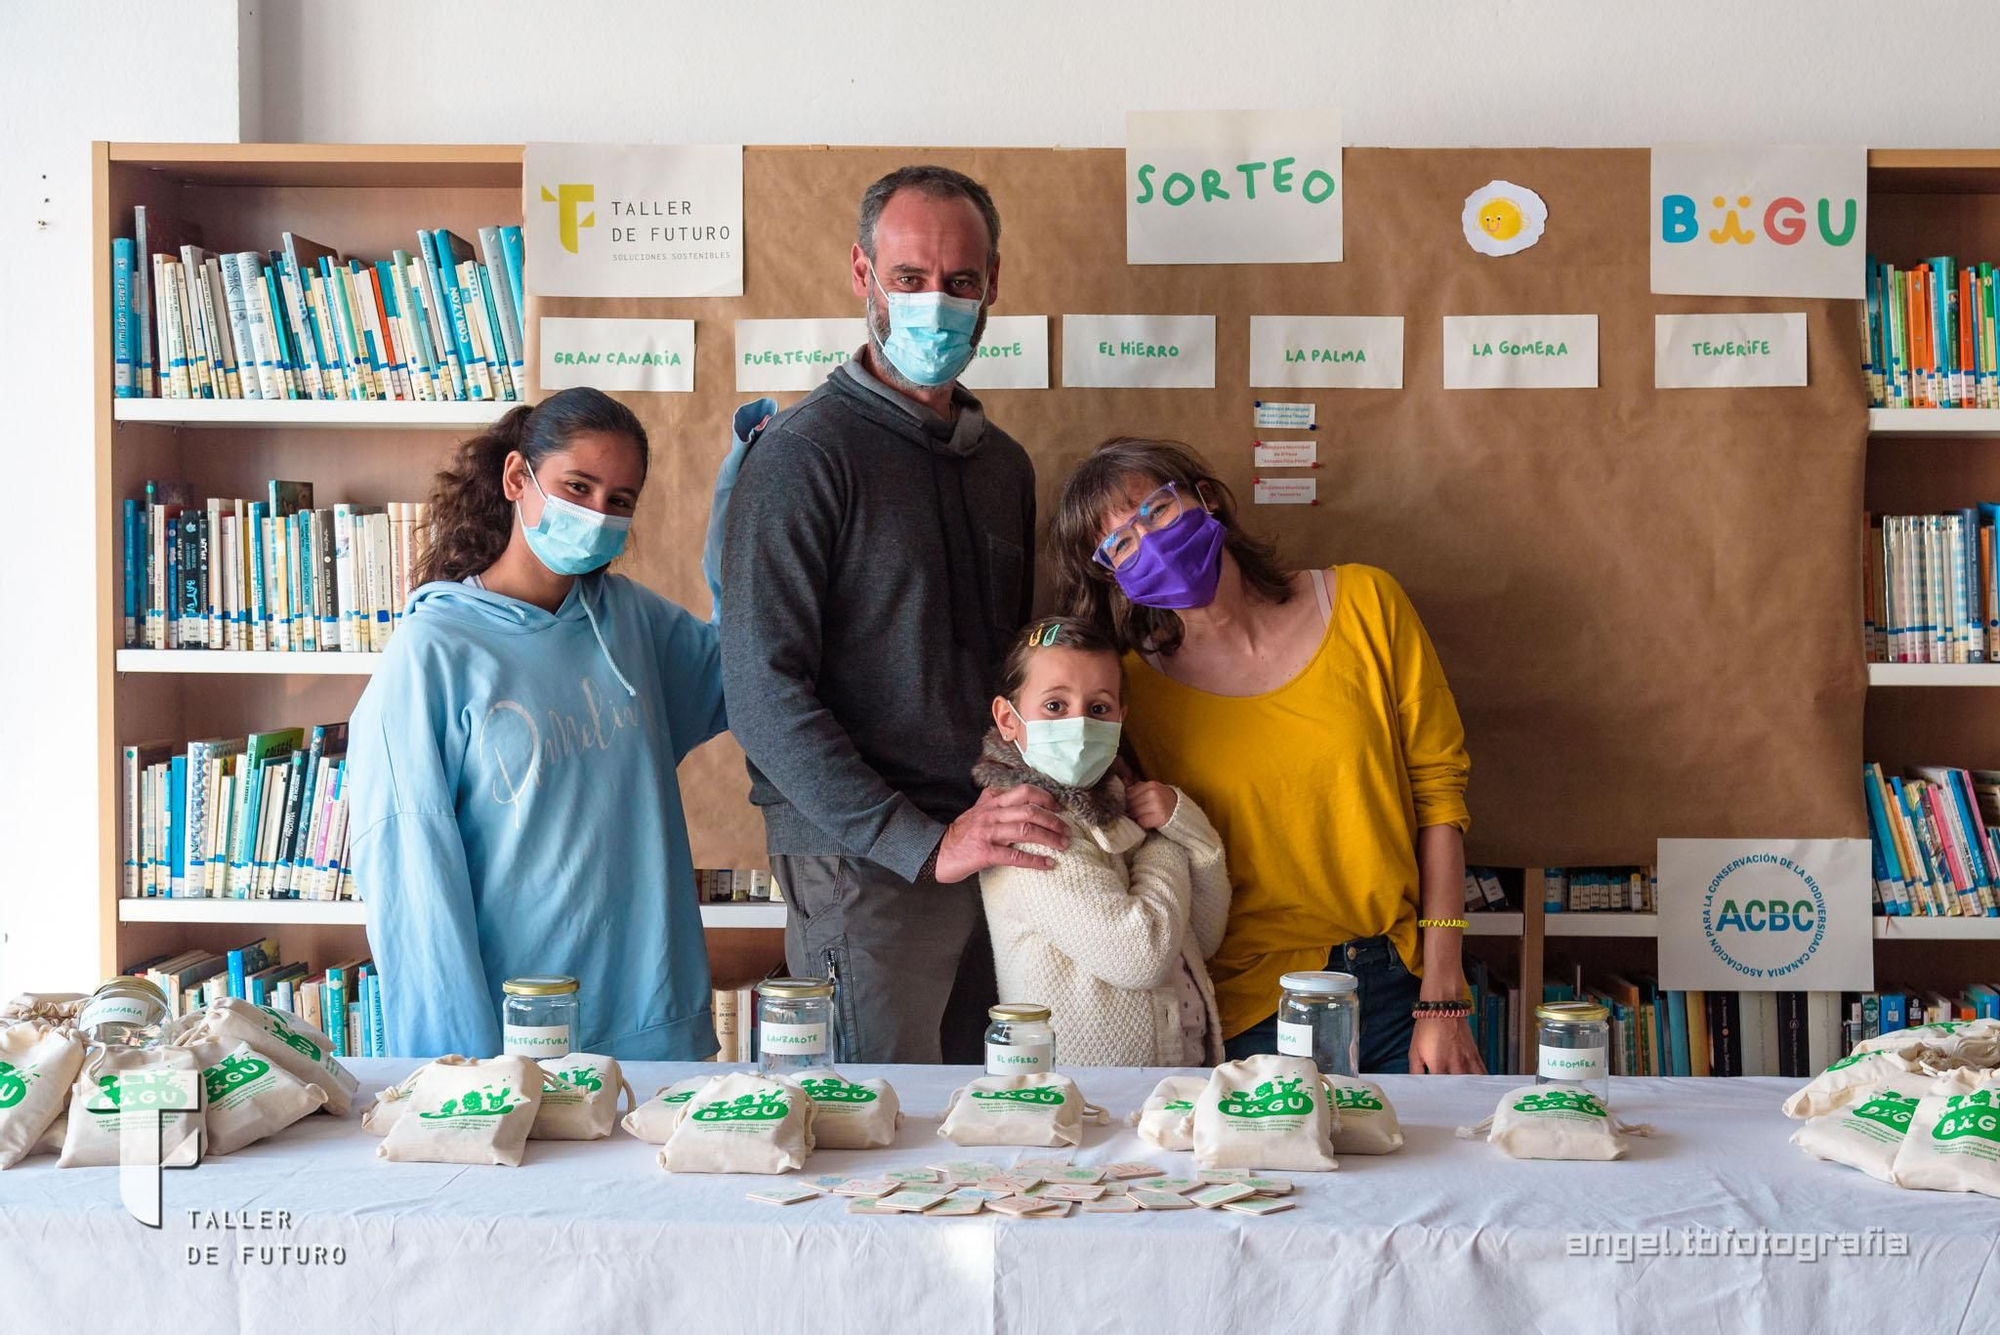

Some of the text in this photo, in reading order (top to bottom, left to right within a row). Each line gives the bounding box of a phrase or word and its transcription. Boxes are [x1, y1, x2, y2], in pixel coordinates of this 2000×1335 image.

[1135, 155, 1338, 208] SORTEO
[611, 200, 692, 216] TALLER
[611, 226, 731, 242] DE FUTURO
[612, 251, 731, 261] SOLUCIONES SOSTENIBLES
[975, 342, 1023, 359] ROTE
[1098, 341, 1116, 358] EL
[1284, 348, 1367, 364] LA PALMA
[1471, 340, 1569, 358] LA GOMERA
[553, 351, 602, 366] GRAN
[1702, 852, 1827, 978] ASOCIACIÓN PARA LA CONSERVACIÓN DE LA BIODIVERSIDAD CANARIA
[1715, 899, 1815, 933] ACBC
[766, 1033, 819, 1045] LANZAROTE
